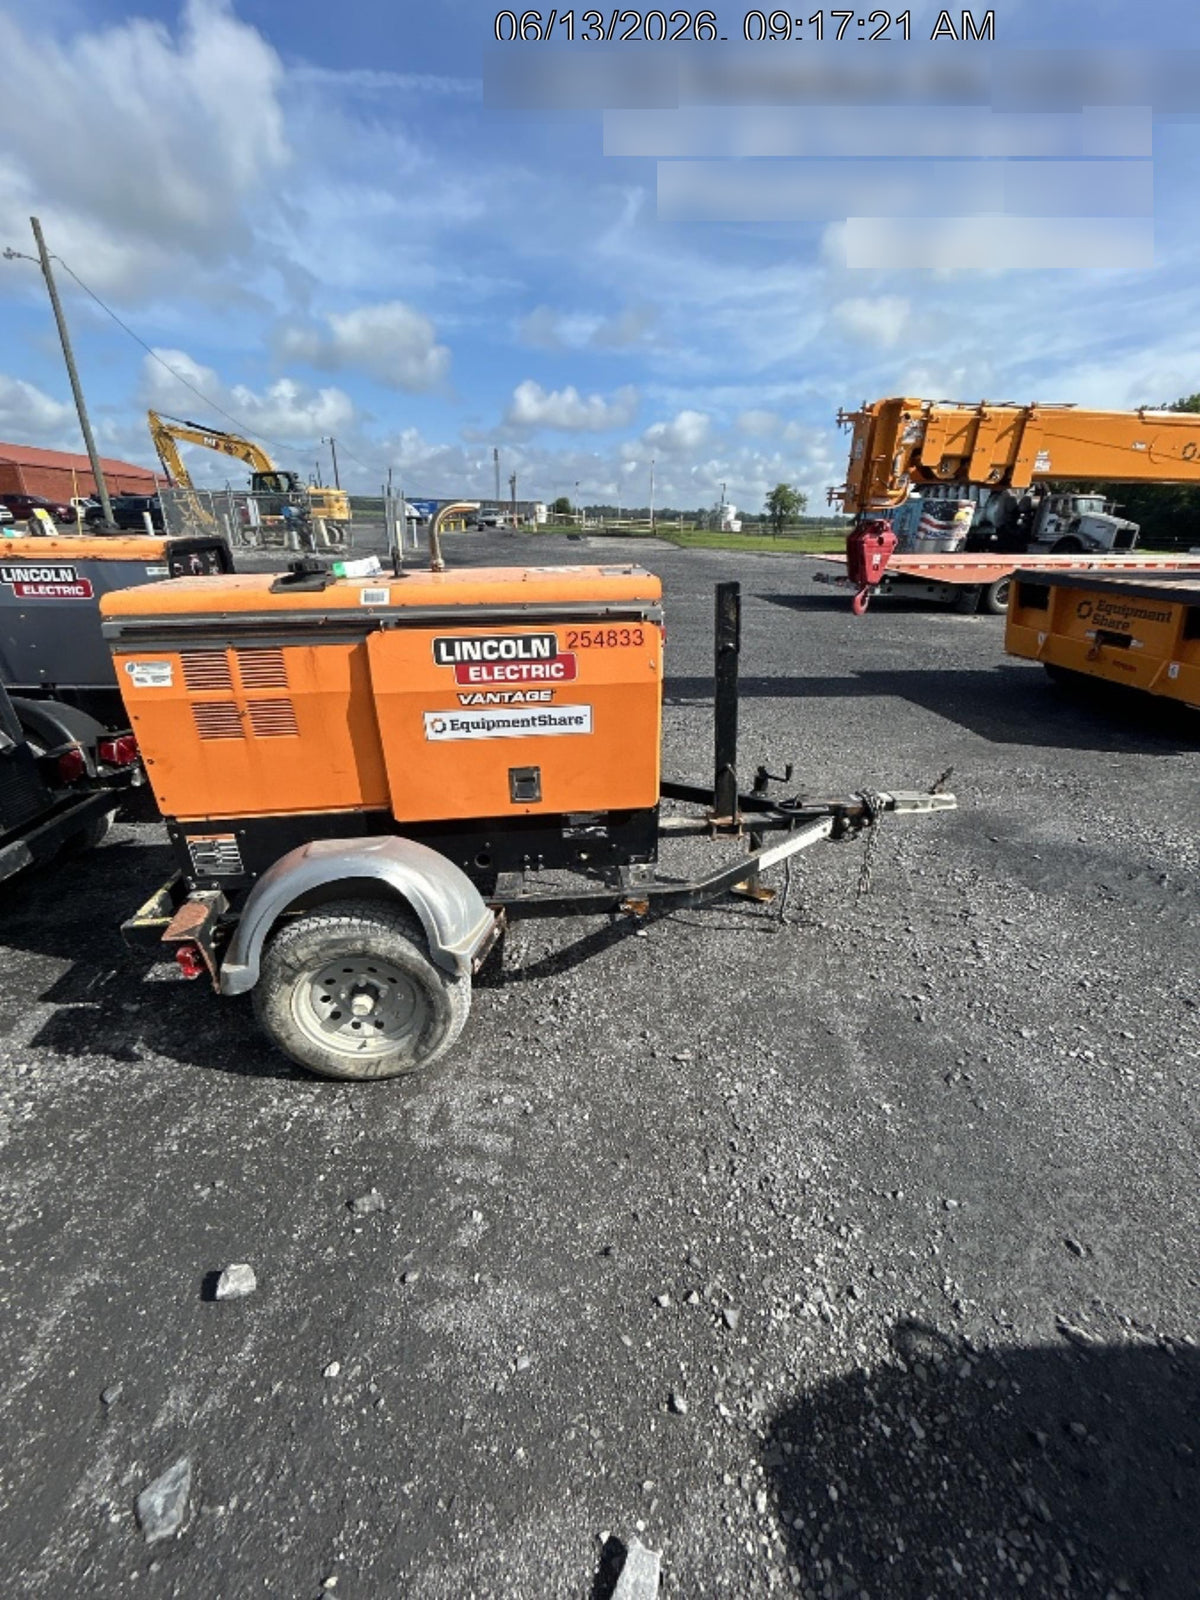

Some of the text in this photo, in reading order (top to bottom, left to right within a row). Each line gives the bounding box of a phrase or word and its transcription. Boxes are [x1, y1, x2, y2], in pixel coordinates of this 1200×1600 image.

[1, 568, 74, 582] LINCOLN
[23, 584, 84, 595] ELECTRIC
[1097, 600, 1172, 622] Equipment
[1092, 613, 1129, 630] Share
[566, 629, 645, 649] 254833
[440, 638, 550, 662] LINCOLN
[468, 662, 565, 681] ELECTRIC
[458, 691, 552, 704] VANTAGE
[450, 714, 584, 733] EquipmentShare
